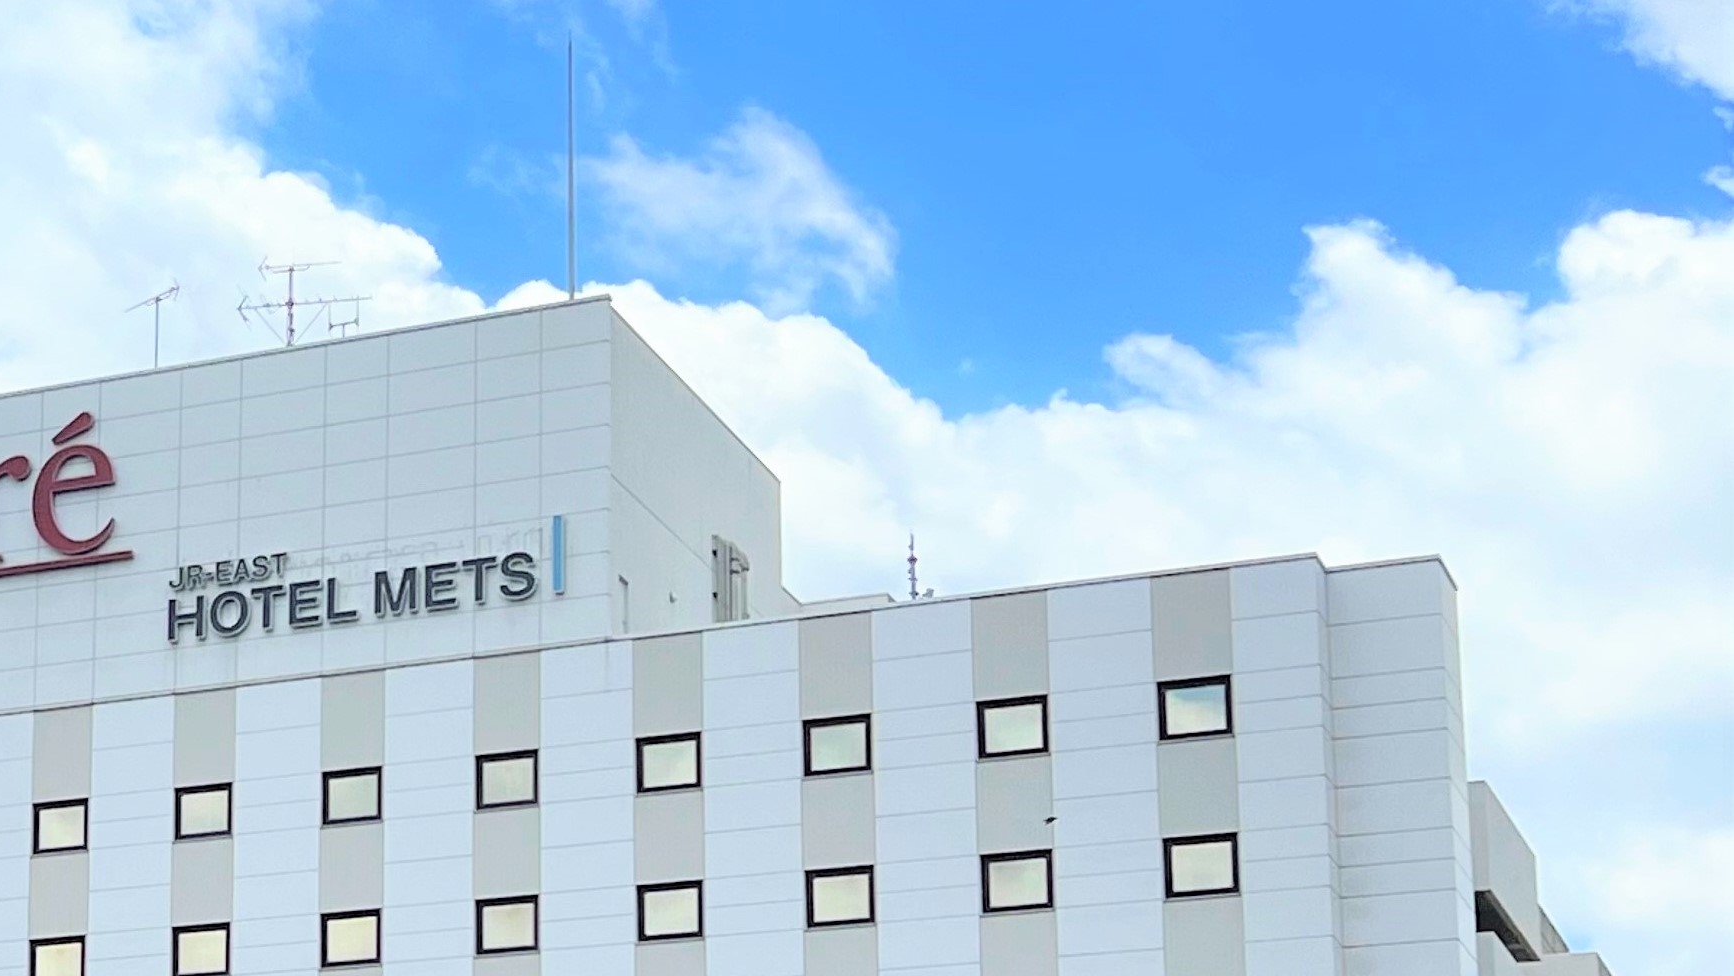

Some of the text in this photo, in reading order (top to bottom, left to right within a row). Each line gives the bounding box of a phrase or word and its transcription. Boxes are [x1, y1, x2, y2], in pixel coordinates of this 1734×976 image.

[166, 551, 540, 644] HOTEL METS
[168, 551, 289, 592] JR-EAST
